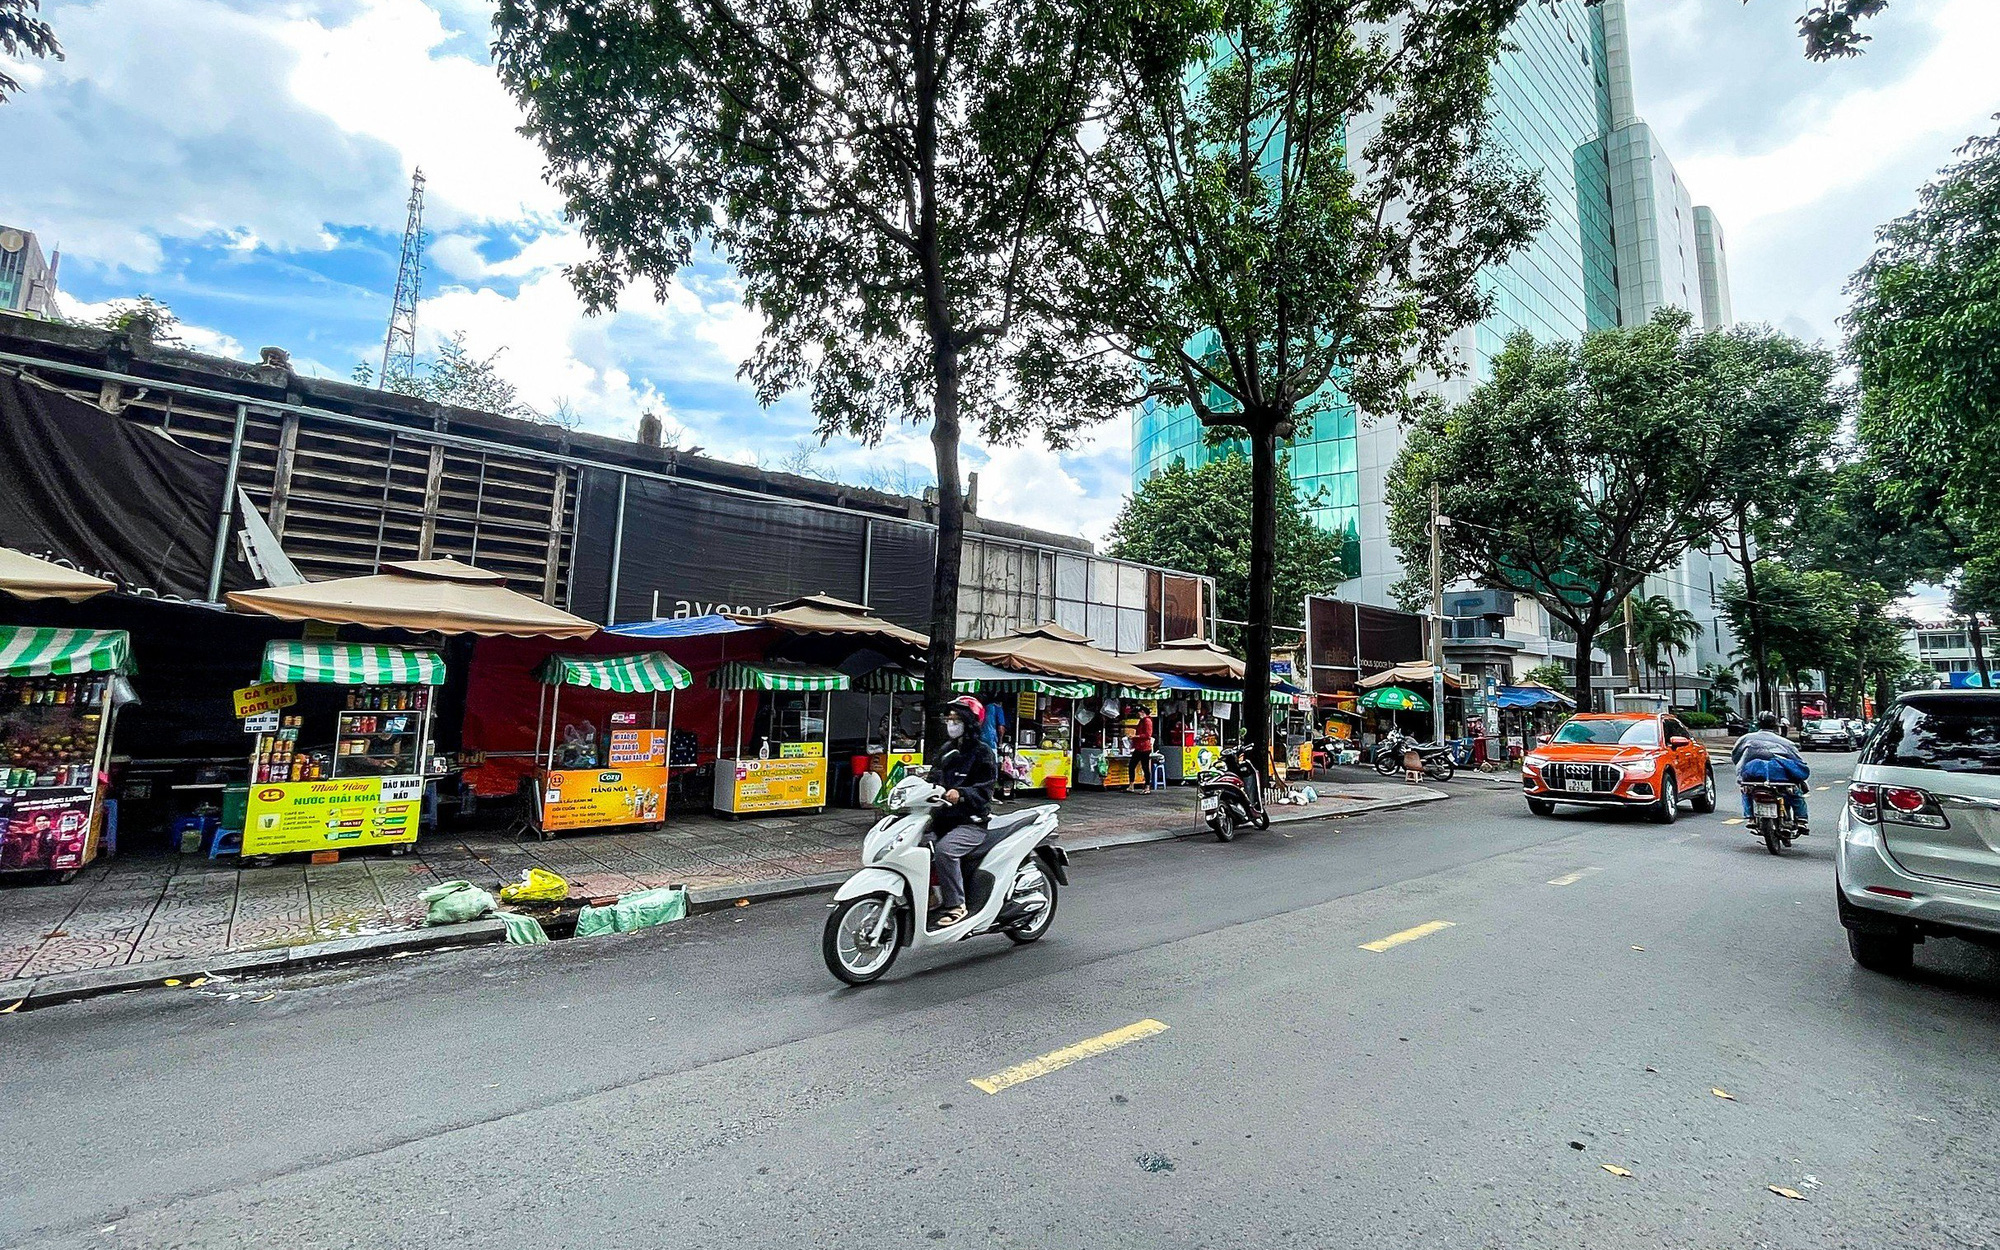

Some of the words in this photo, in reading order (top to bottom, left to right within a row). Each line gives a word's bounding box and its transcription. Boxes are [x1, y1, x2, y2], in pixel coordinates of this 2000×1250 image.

[652, 590, 782, 621] Lavenu
[601, 773, 621, 782] Cozy
[310, 783, 339, 793] Minh
